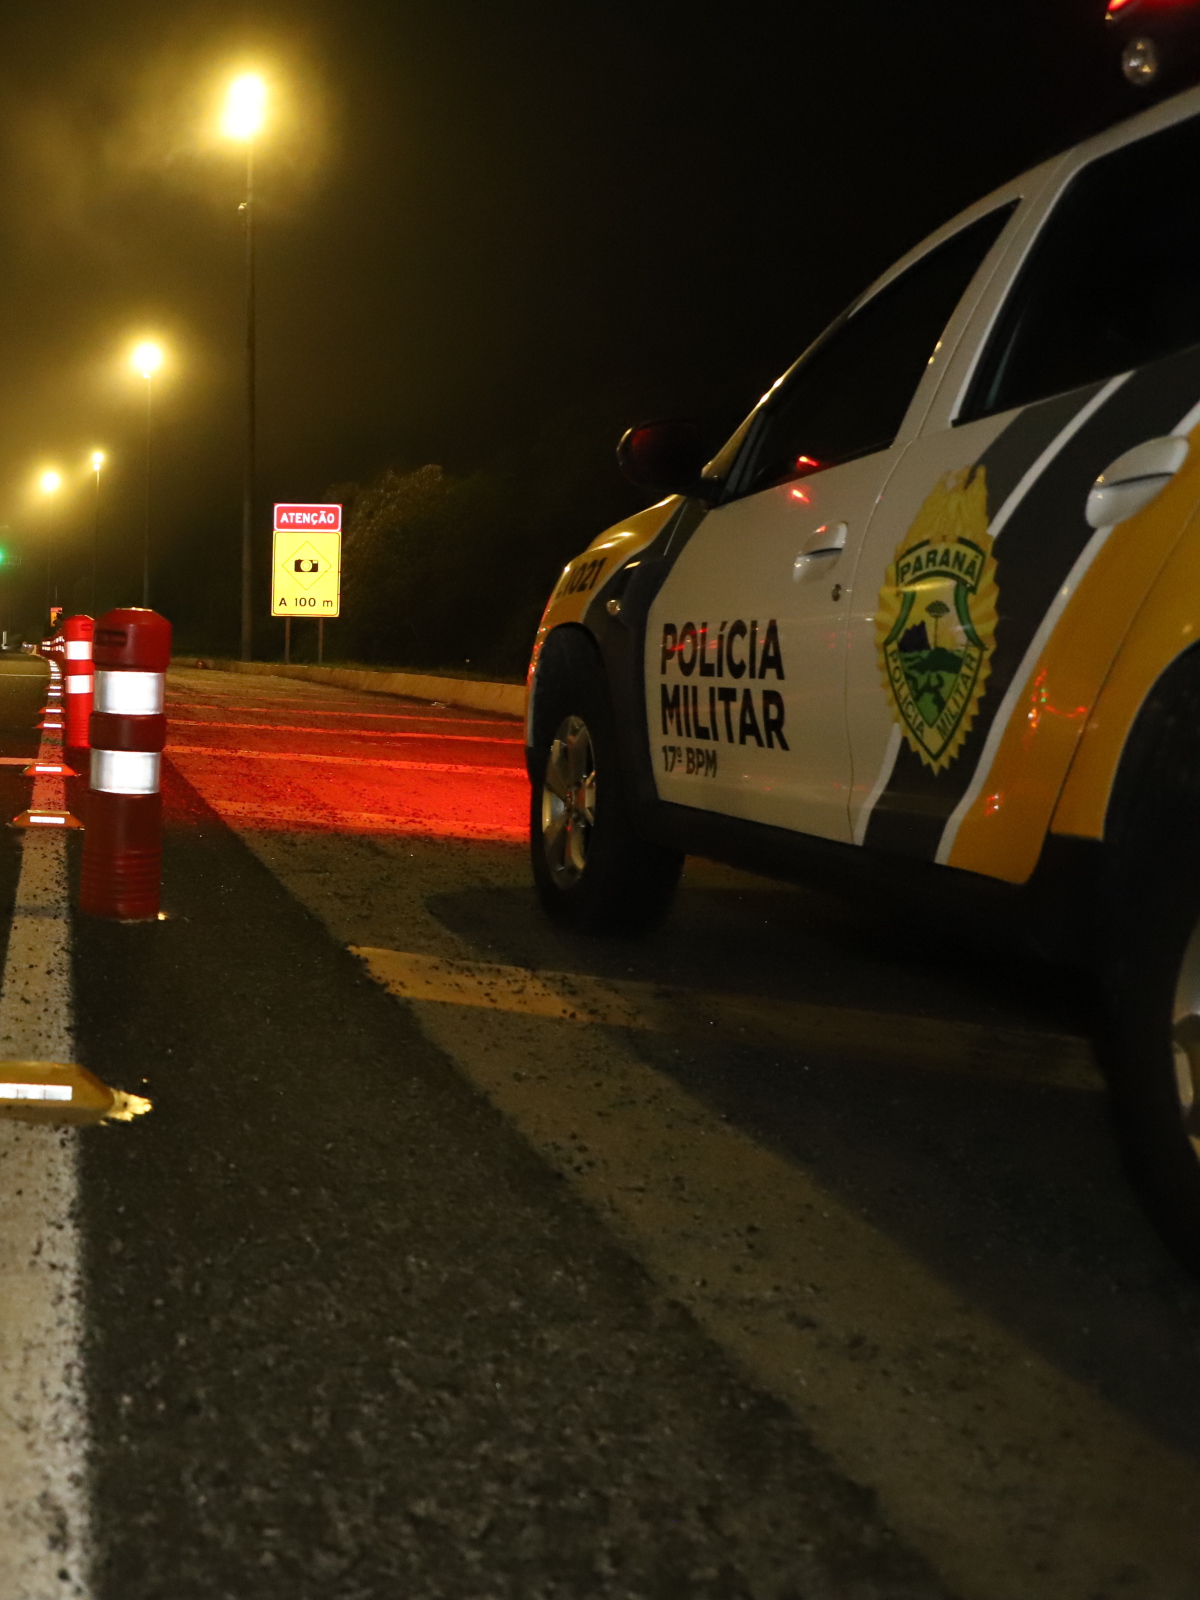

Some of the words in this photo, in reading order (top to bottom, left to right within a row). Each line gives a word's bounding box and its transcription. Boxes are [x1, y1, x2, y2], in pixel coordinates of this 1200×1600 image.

[280, 511, 335, 525] ATENÇÃO
[900, 548, 980, 583] PARANÁ
[278, 597, 287, 607] A
[295, 597, 316, 607] 100
[322, 599, 333, 607] m
[661, 619, 785, 680] POLÍCIA
[936, 652, 978, 740] MILITAR
[661, 684, 790, 751] MILITAR
[685, 747, 718, 778] BPM
